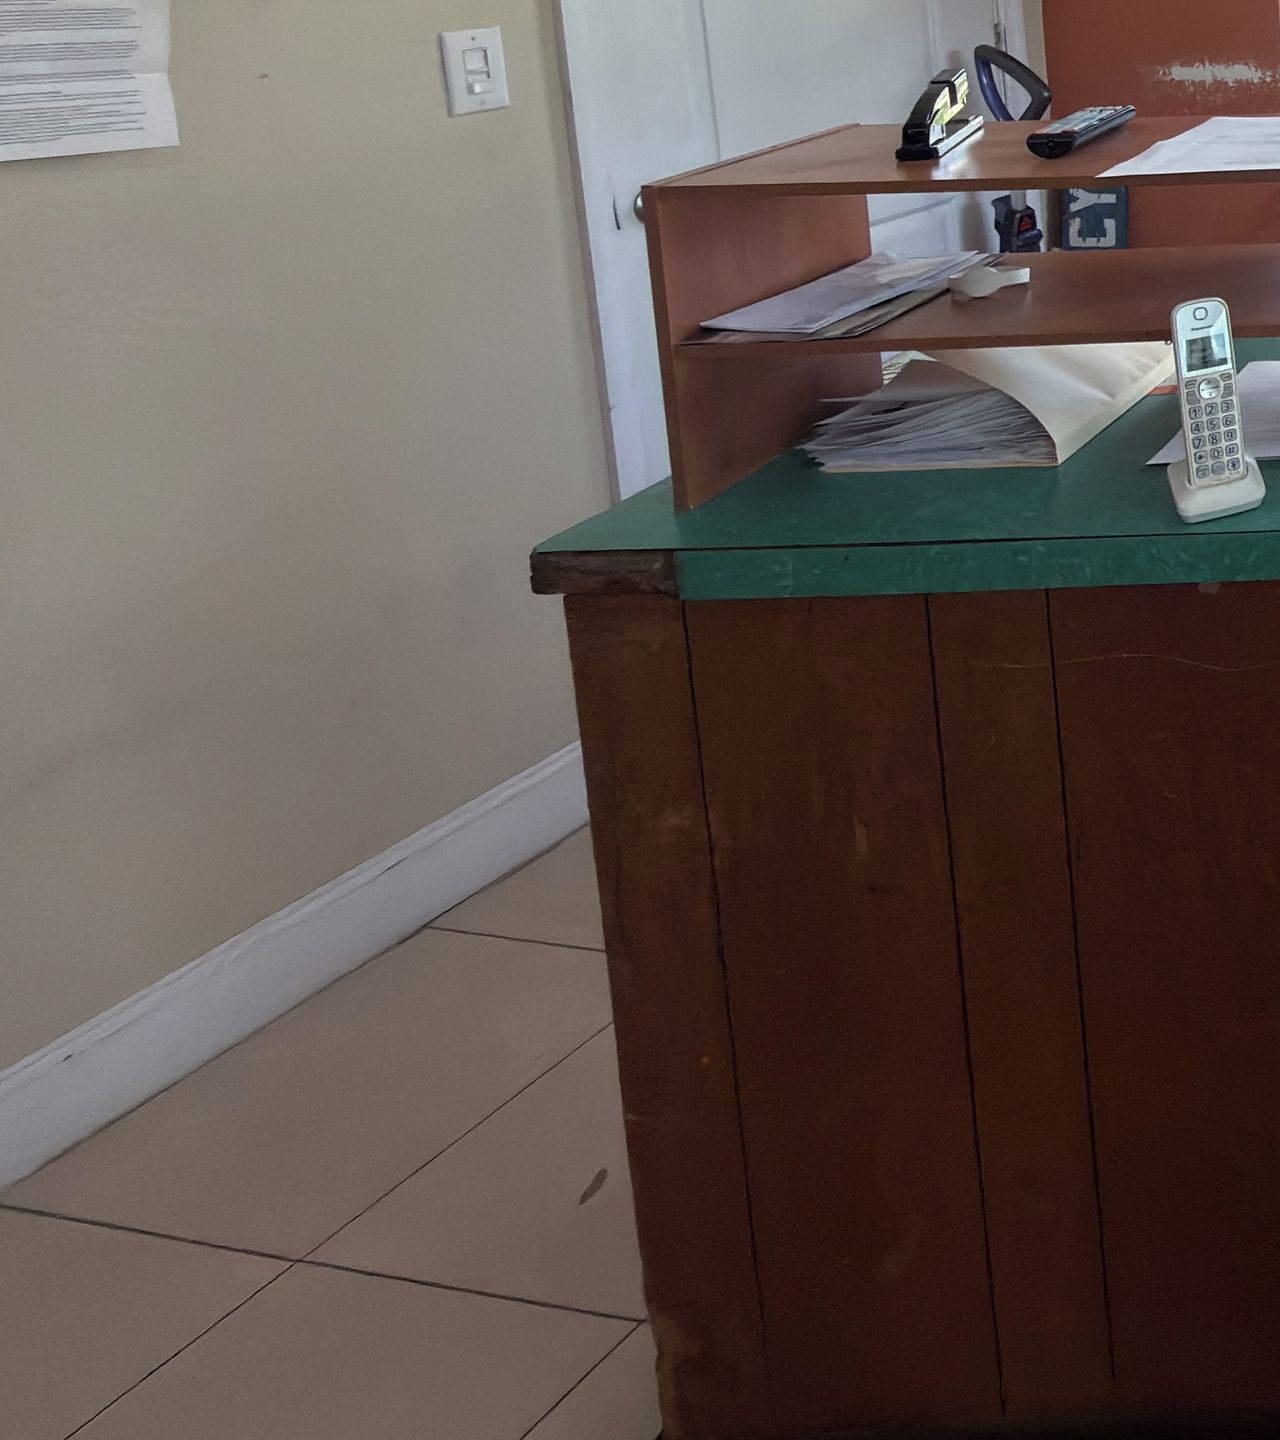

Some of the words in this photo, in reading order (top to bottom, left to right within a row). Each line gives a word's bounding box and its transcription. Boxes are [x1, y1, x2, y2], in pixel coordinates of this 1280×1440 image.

[1207, 405, 1215, 416] 2
[1193, 423, 1201, 433] 4
[1209, 420, 1216, 430] 5
[1225, 416, 1232, 427] 6
[1210, 434, 1218, 445] 8
[1212, 449, 1220, 460] 0
